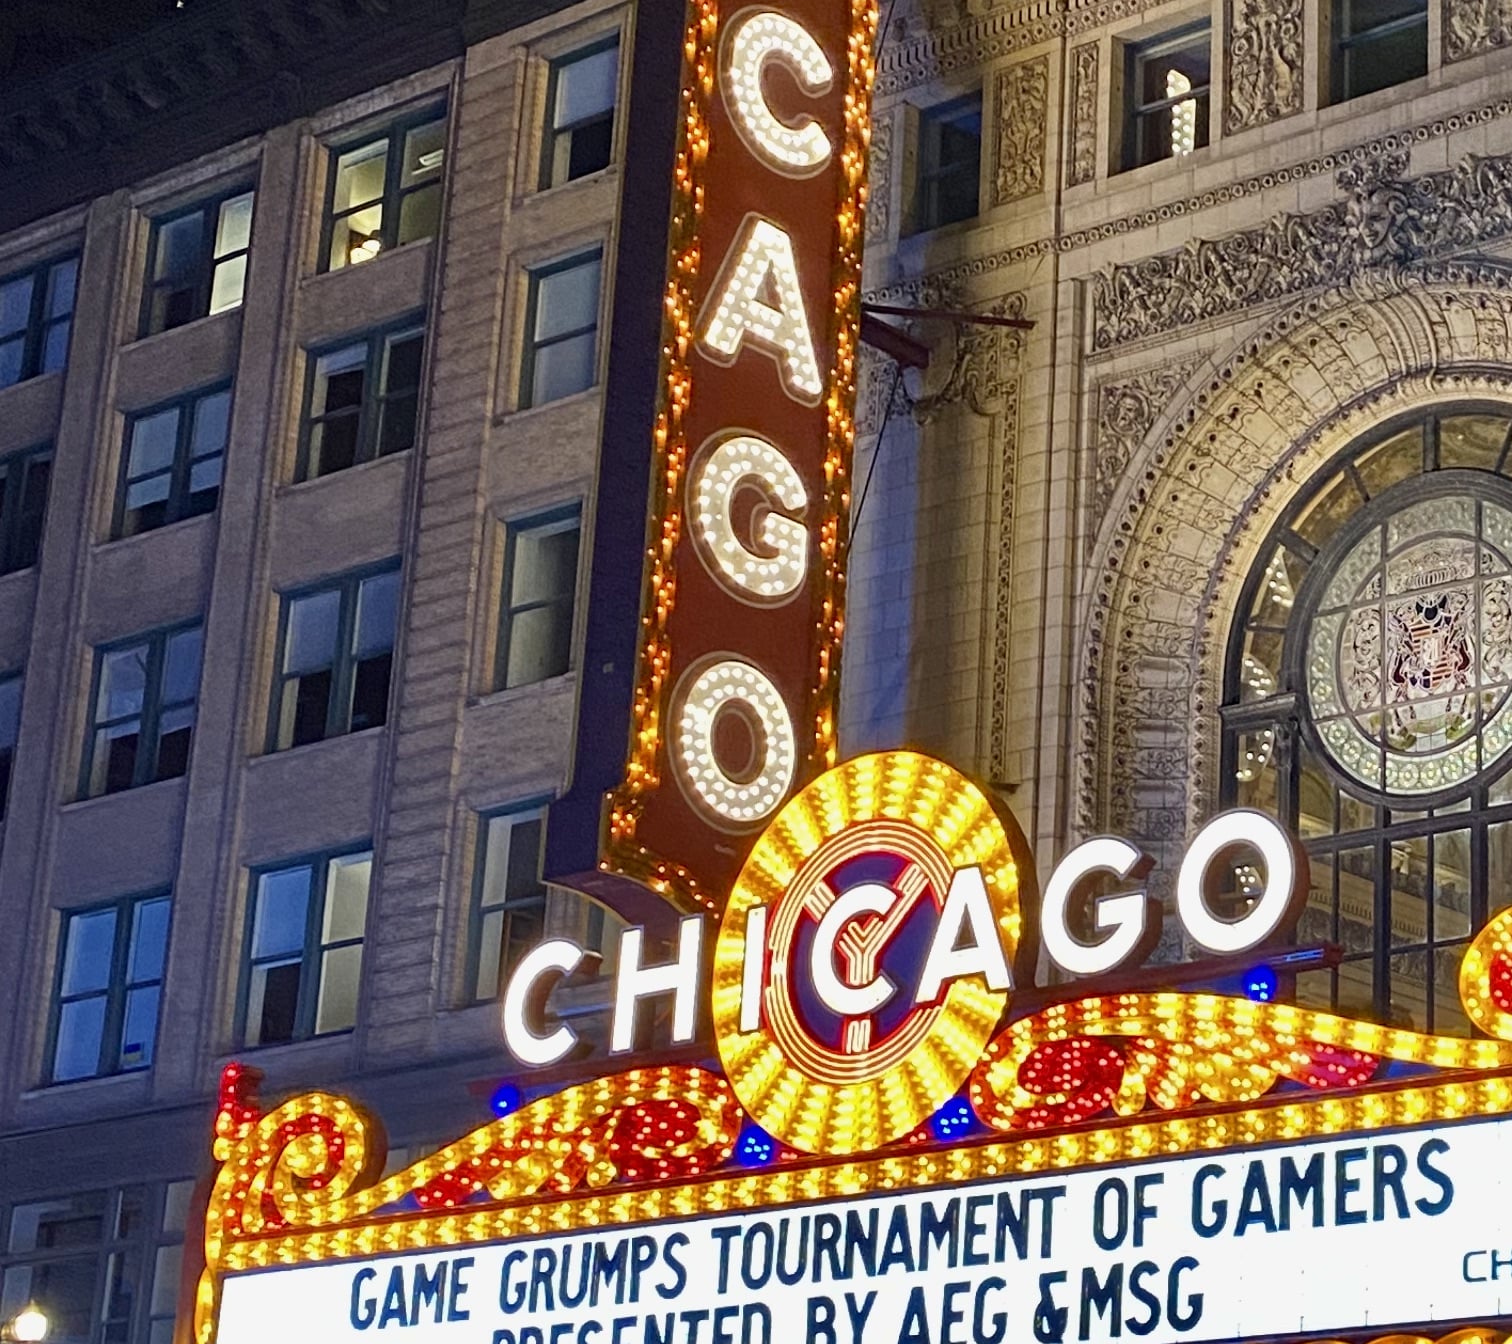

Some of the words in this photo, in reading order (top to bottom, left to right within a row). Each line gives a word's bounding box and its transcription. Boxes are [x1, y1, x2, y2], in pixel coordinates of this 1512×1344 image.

[503, 811, 1293, 1066] CHICAGO
[349, 1256, 475, 1331] GAME
[499, 1231, 691, 1315] GRUMPS
[710, 1185, 1067, 1295] TOURNAMENT
[1092, 1172, 1165, 1252] OF
[1191, 1137, 1455, 1239] GAMERS
